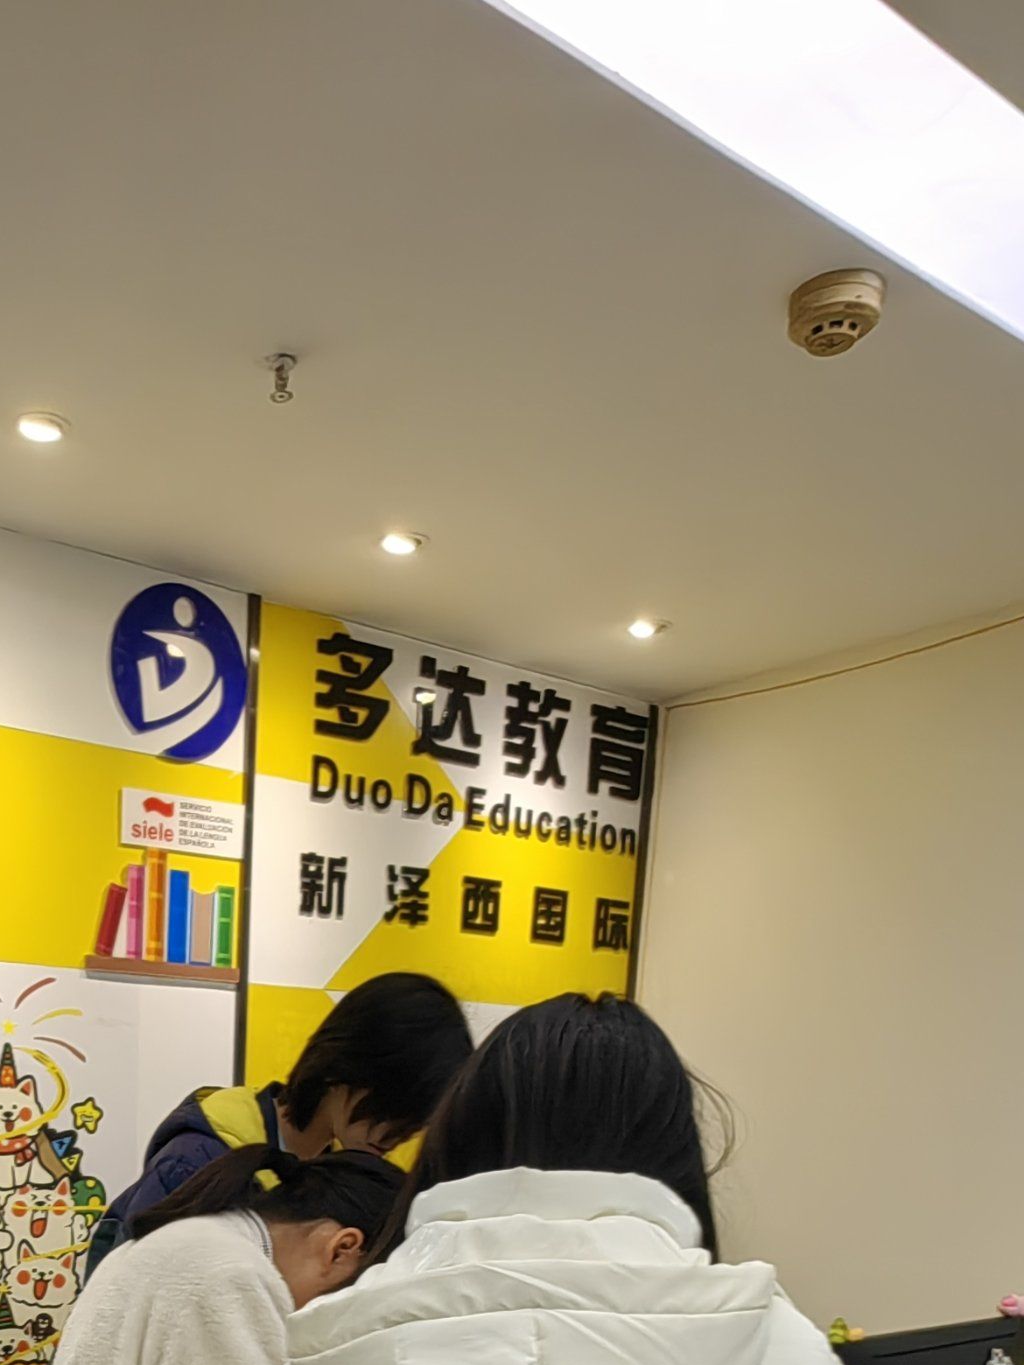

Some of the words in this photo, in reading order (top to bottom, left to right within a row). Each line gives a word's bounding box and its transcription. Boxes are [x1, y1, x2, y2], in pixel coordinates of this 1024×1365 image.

[313, 633, 650, 801] 多达教育
[131, 820, 174, 842] siele
[179, 802, 212, 813] SERVICIO
[310, 756, 394, 809] Duo
[400, 774, 454, 822] Da
[464, 787, 637, 856] Education
[299, 852, 630, 951] 新泽西国际
